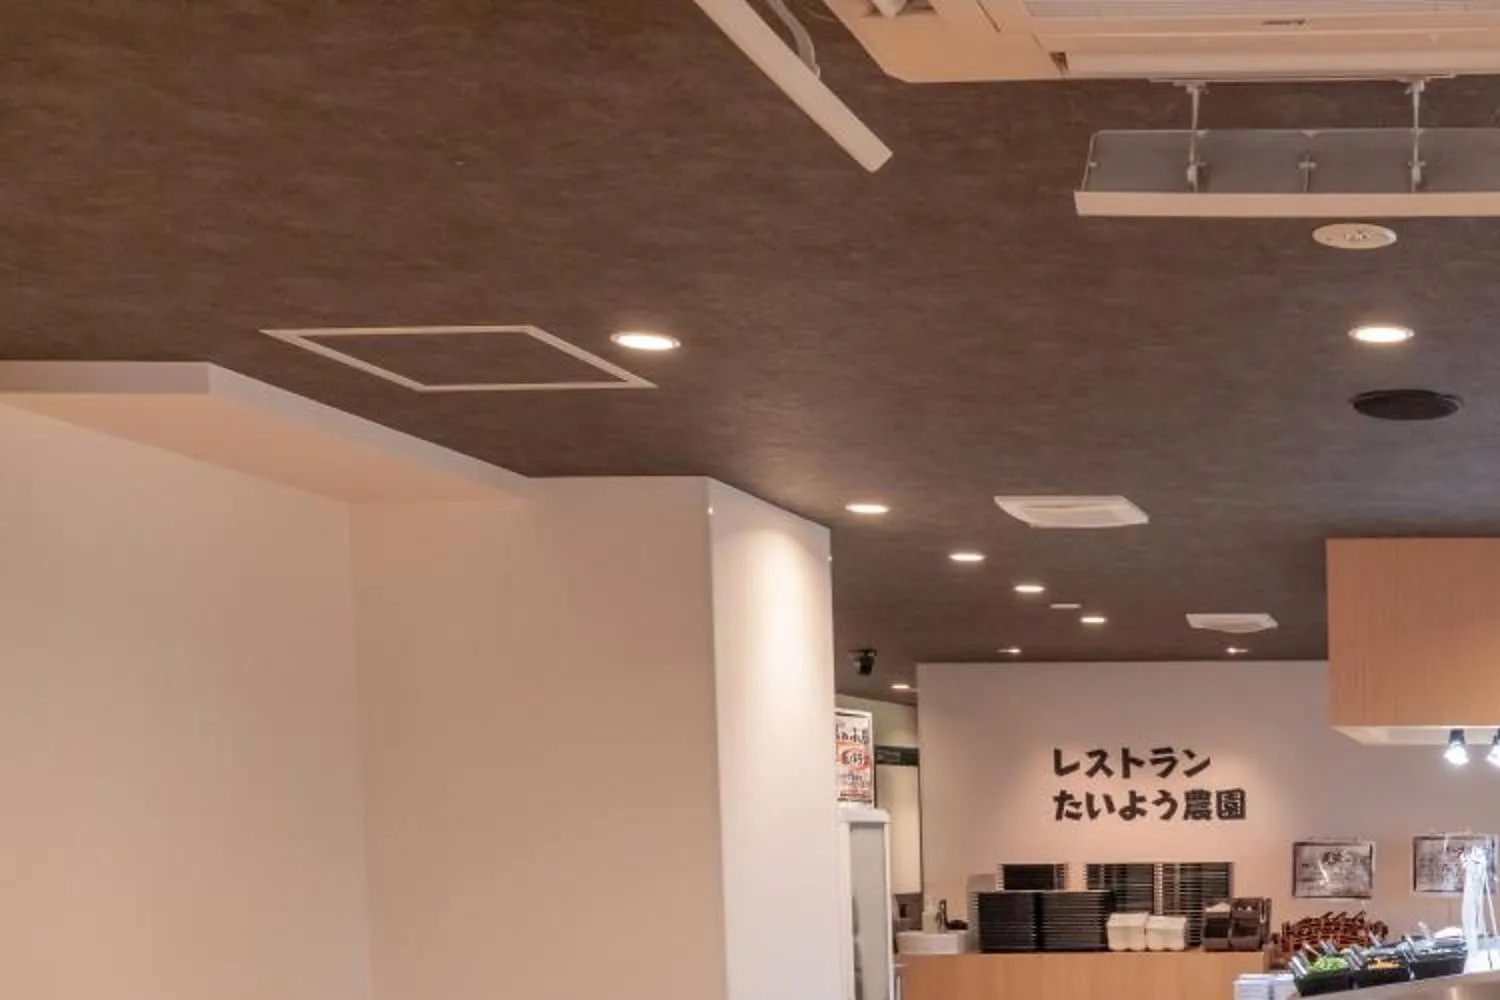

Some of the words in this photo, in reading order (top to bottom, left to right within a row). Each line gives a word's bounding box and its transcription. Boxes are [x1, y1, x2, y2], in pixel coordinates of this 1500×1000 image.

[1053, 747, 1211, 779] レストラン
[1053, 788, 1246, 821] たいよう農園
